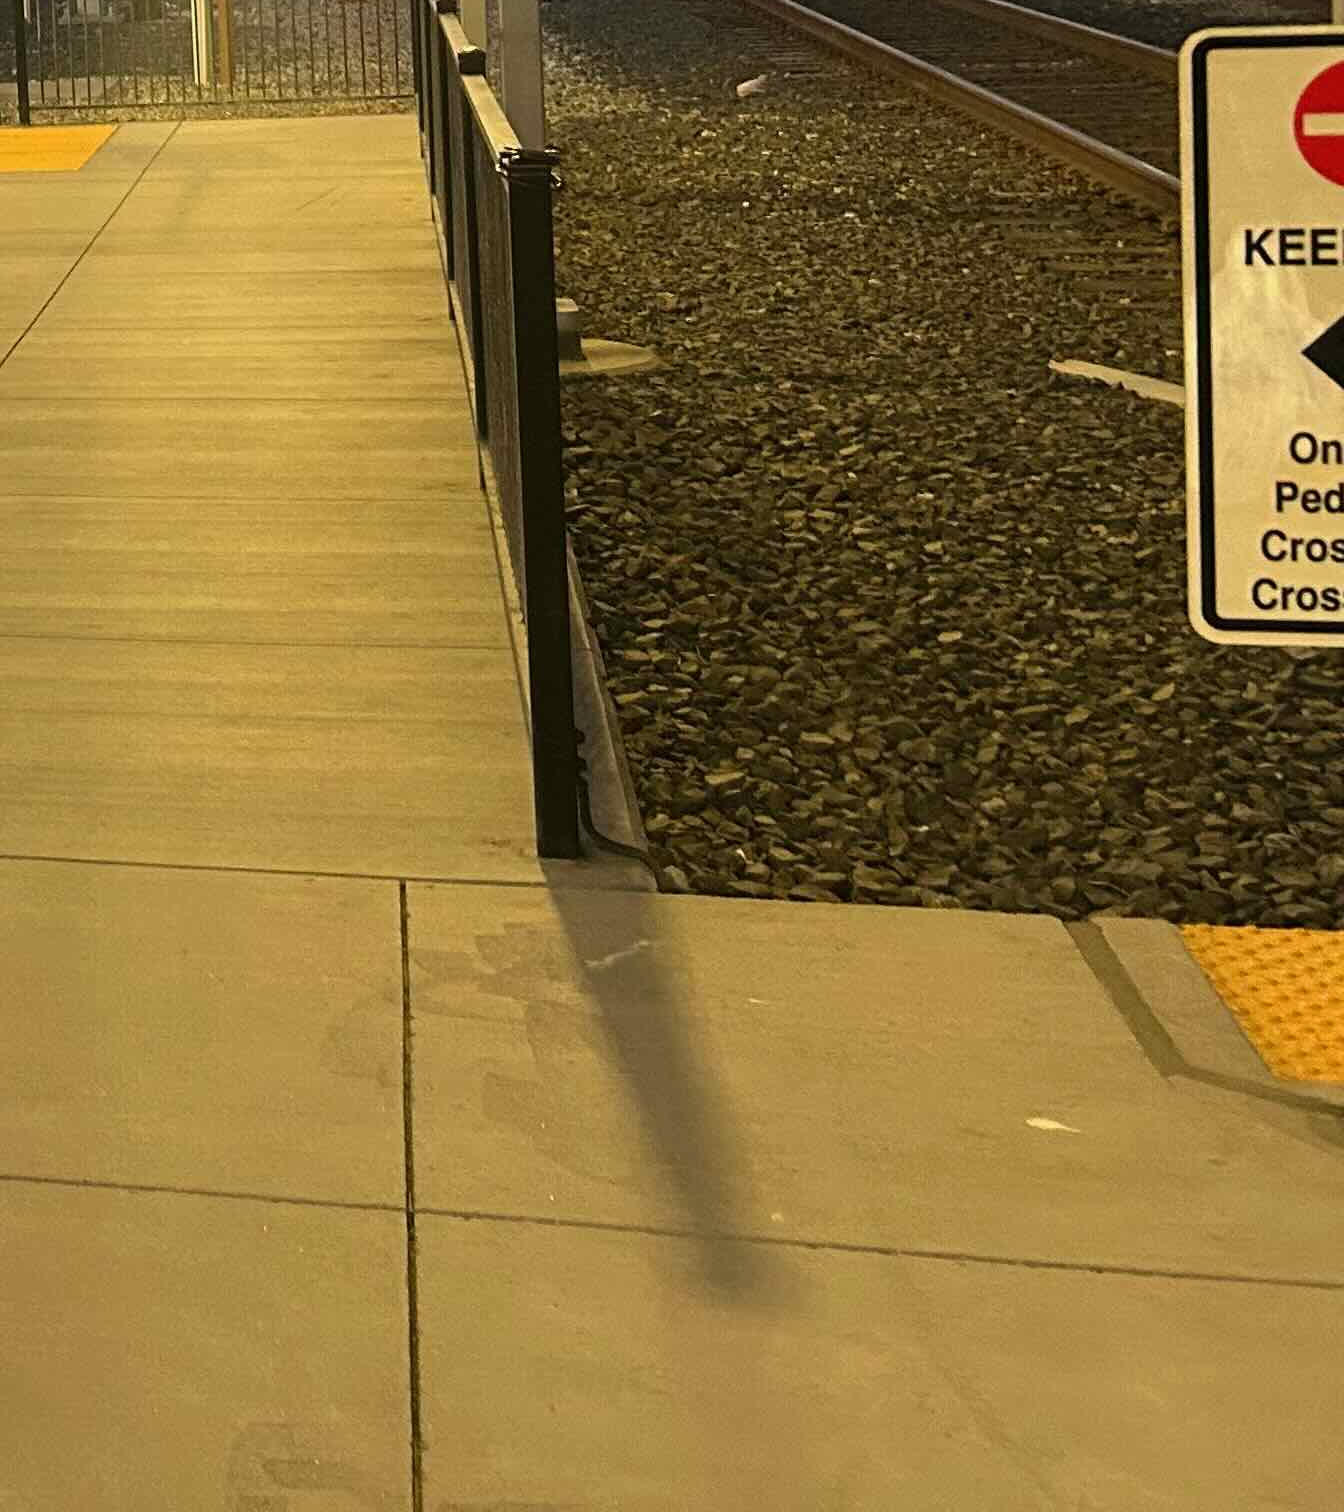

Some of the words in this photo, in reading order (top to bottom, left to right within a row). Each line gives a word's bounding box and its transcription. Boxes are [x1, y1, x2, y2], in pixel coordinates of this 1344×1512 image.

[1245, 228, 1344, 266] KEE
[1288, 431, 1344, 465] On
[1274, 480, 1344, 513] Ped
[1261, 528, 1344, 562] Cros
[1251, 577, 1344, 611] Cros
